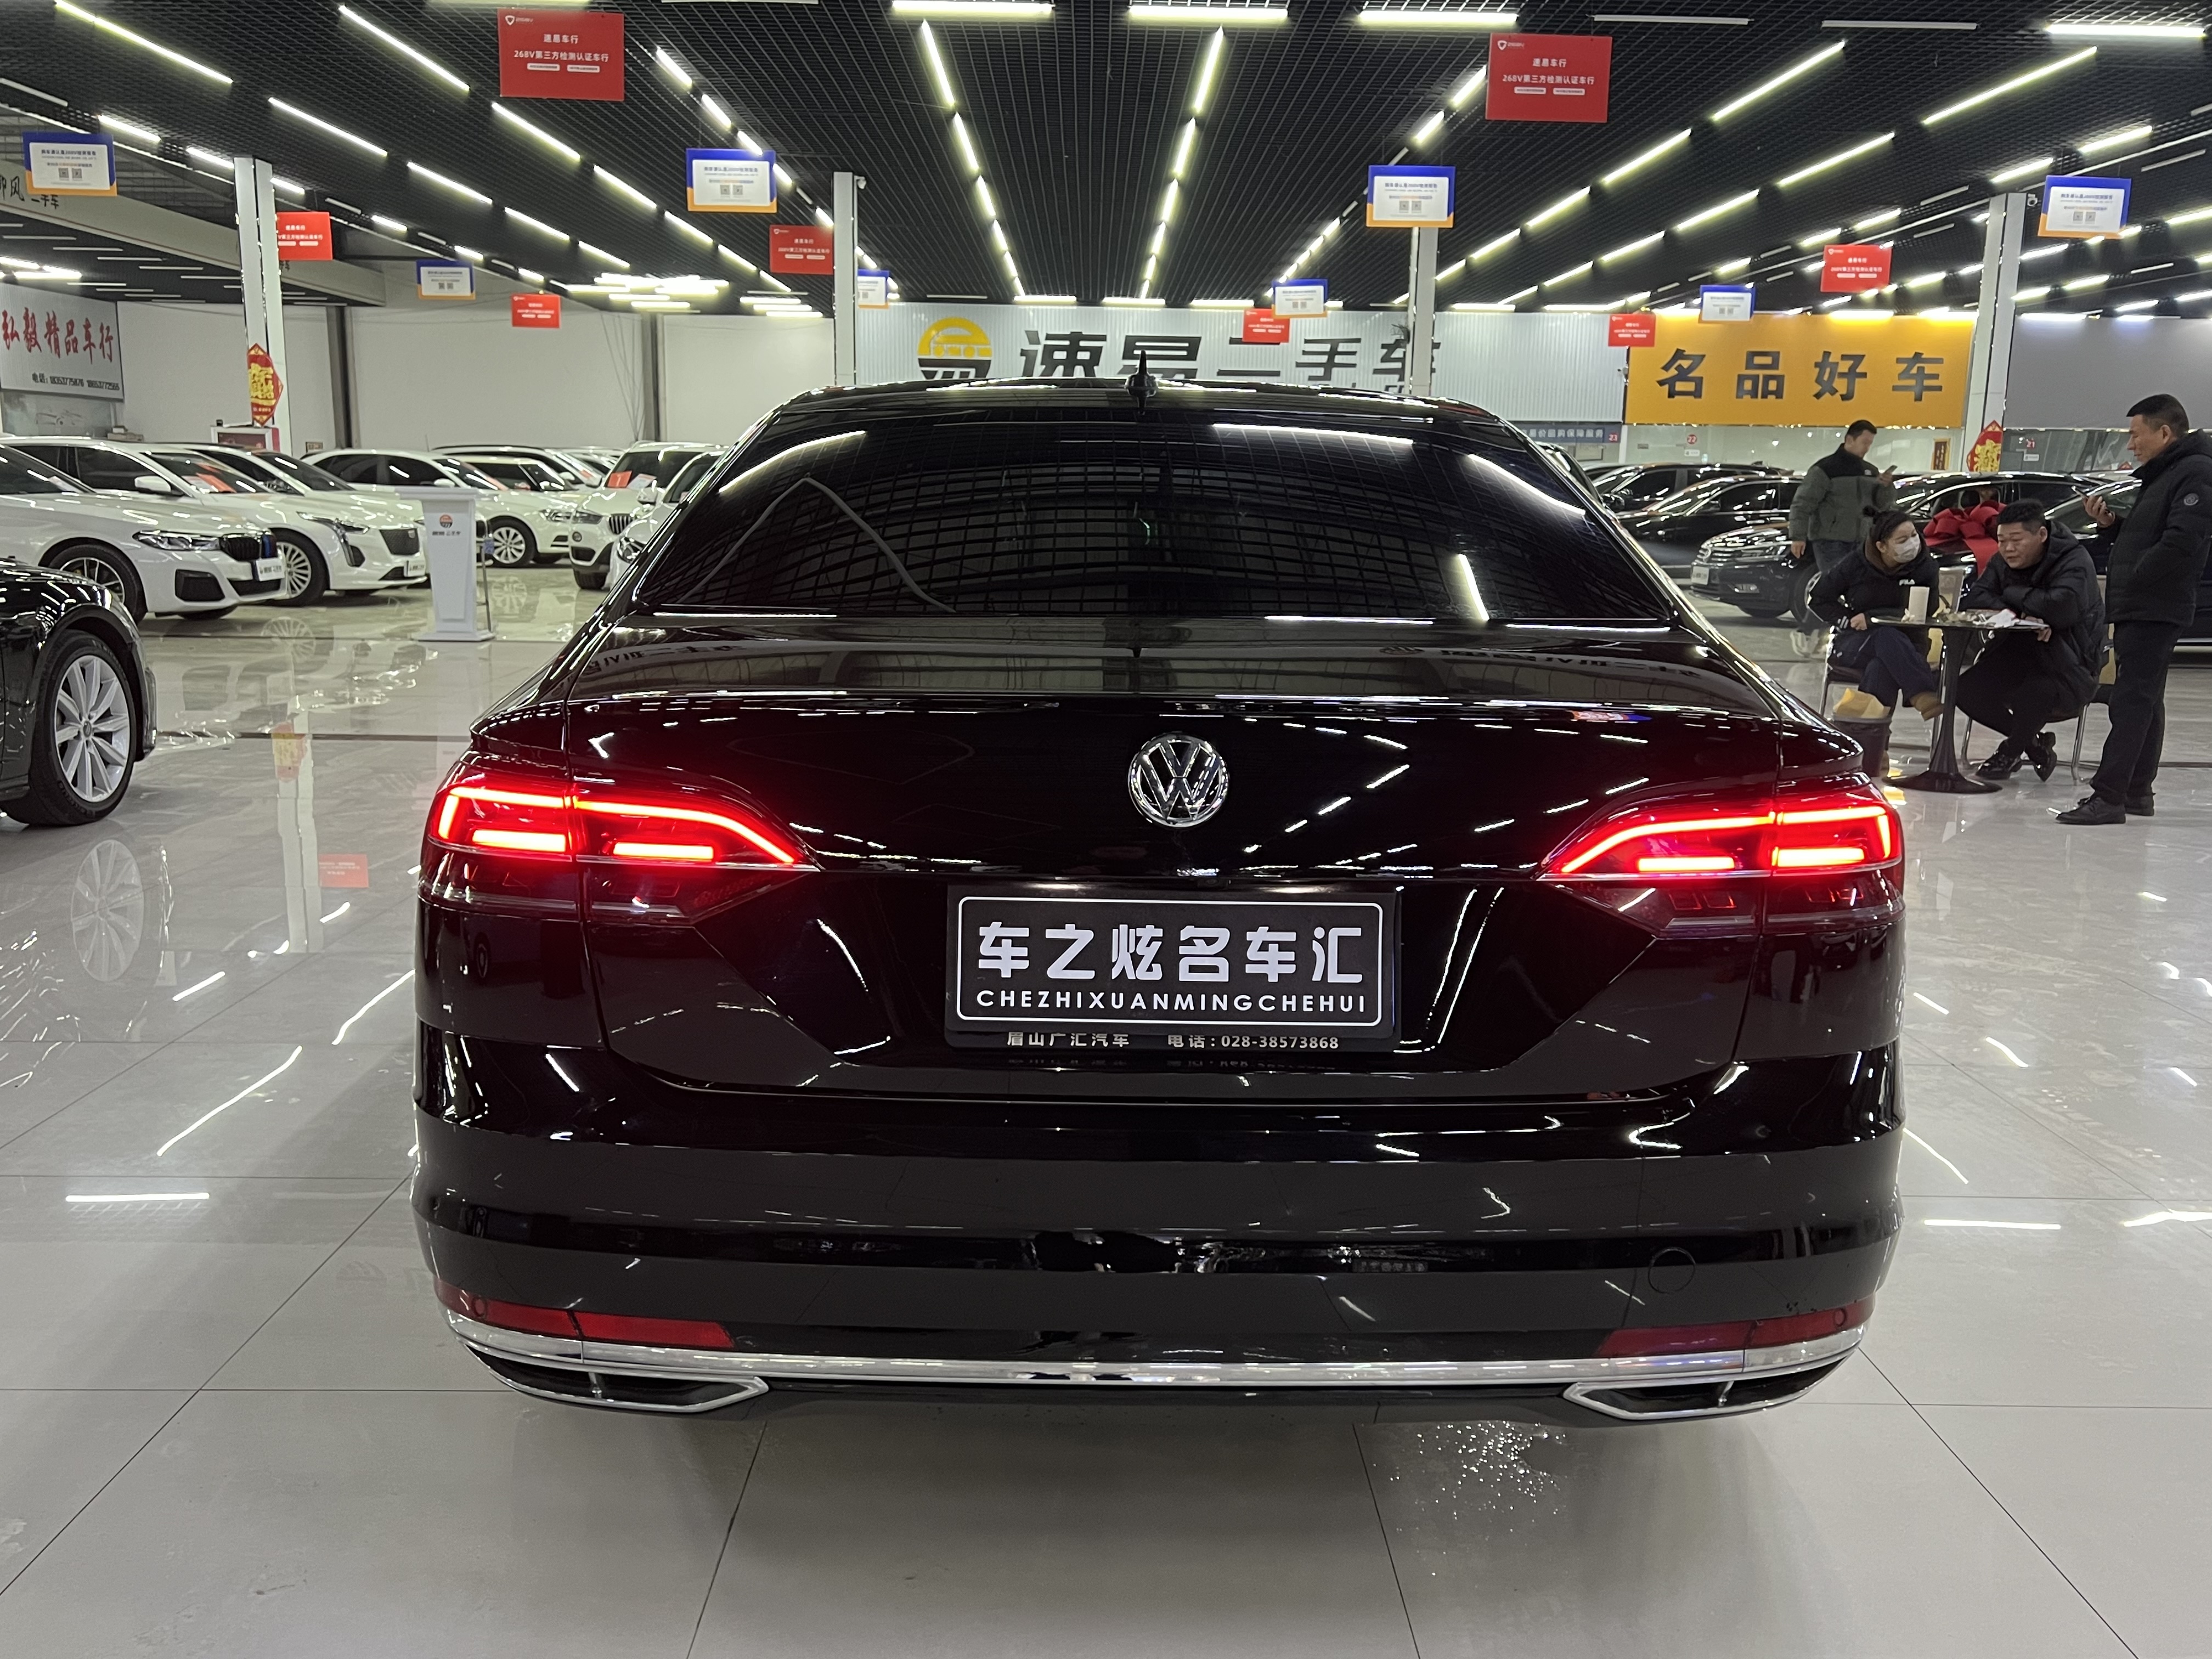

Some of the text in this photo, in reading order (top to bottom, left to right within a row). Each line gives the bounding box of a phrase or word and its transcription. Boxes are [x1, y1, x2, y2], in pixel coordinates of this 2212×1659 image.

[1656, 348, 1944, 402] 名品好车
[978, 922, 1363, 984] 车之炫名车汇
[977, 990, 1364, 1013] CHEZHIXUANMINGCHEHUI
[1007, 1031, 1130, 1047] 眉山广汇汽车
